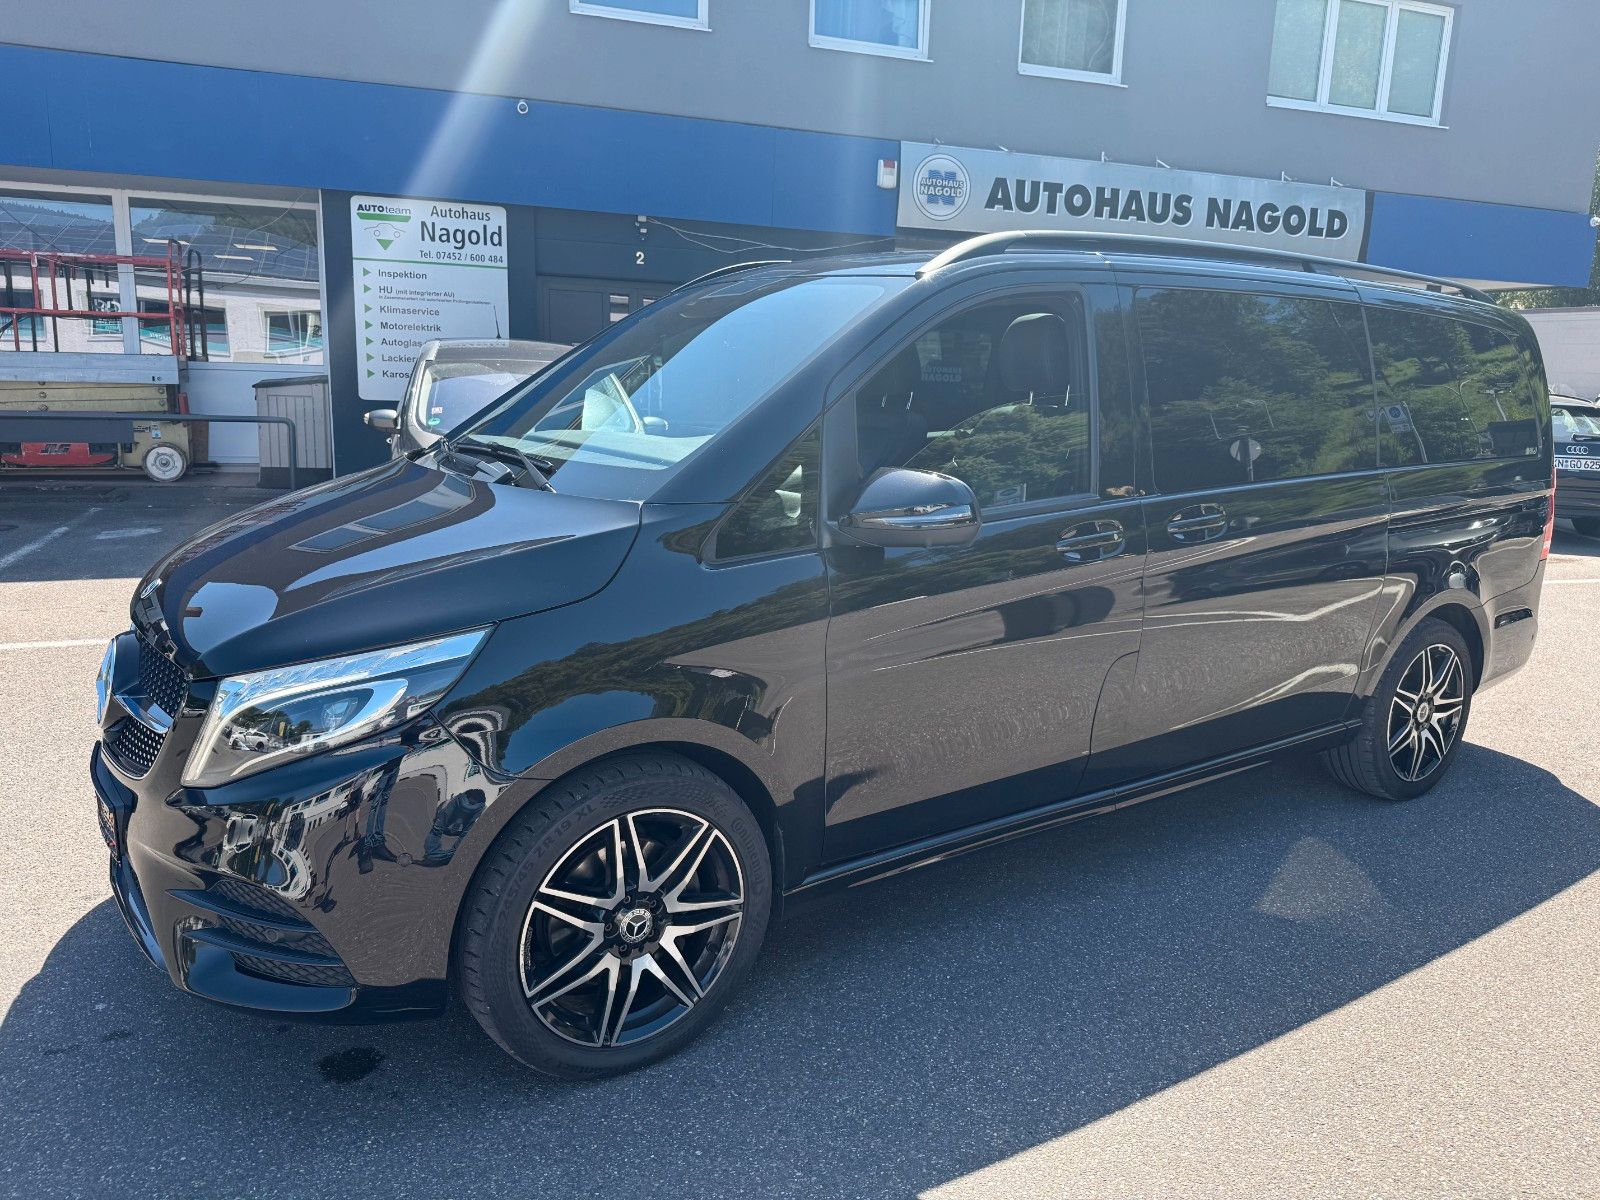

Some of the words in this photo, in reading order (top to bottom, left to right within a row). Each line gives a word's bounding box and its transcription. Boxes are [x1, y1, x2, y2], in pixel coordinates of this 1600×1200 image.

[920, 177, 965, 188] AUTOHAUS
[920, 186, 964, 198] NAGOLD
[356, 203, 412, 215] AUTOteam
[430, 205, 491, 222] Autohaus
[983, 177, 1192, 226] AUTOHAUS
[1206, 197, 1348, 240] NAGOLD
[420, 220, 503, 250] Nagold
[419, 250, 434, 259] Tel.
[436, 251, 463, 261] 07452
[470, 253, 486, 263] 600
[488, 255, 504, 263] 484
[635, 251, 645, 265] 2
[378, 269, 428, 280] Inspektion
[378, 285, 393, 294] HU
[379, 305, 440, 317] Klimaservice
[380, 321, 442, 332] Motorelektrik
[382, 370, 412, 378] Karos
[1569, 460, 1582, 469] GO
[1583, 460, 1600, 470] 625
